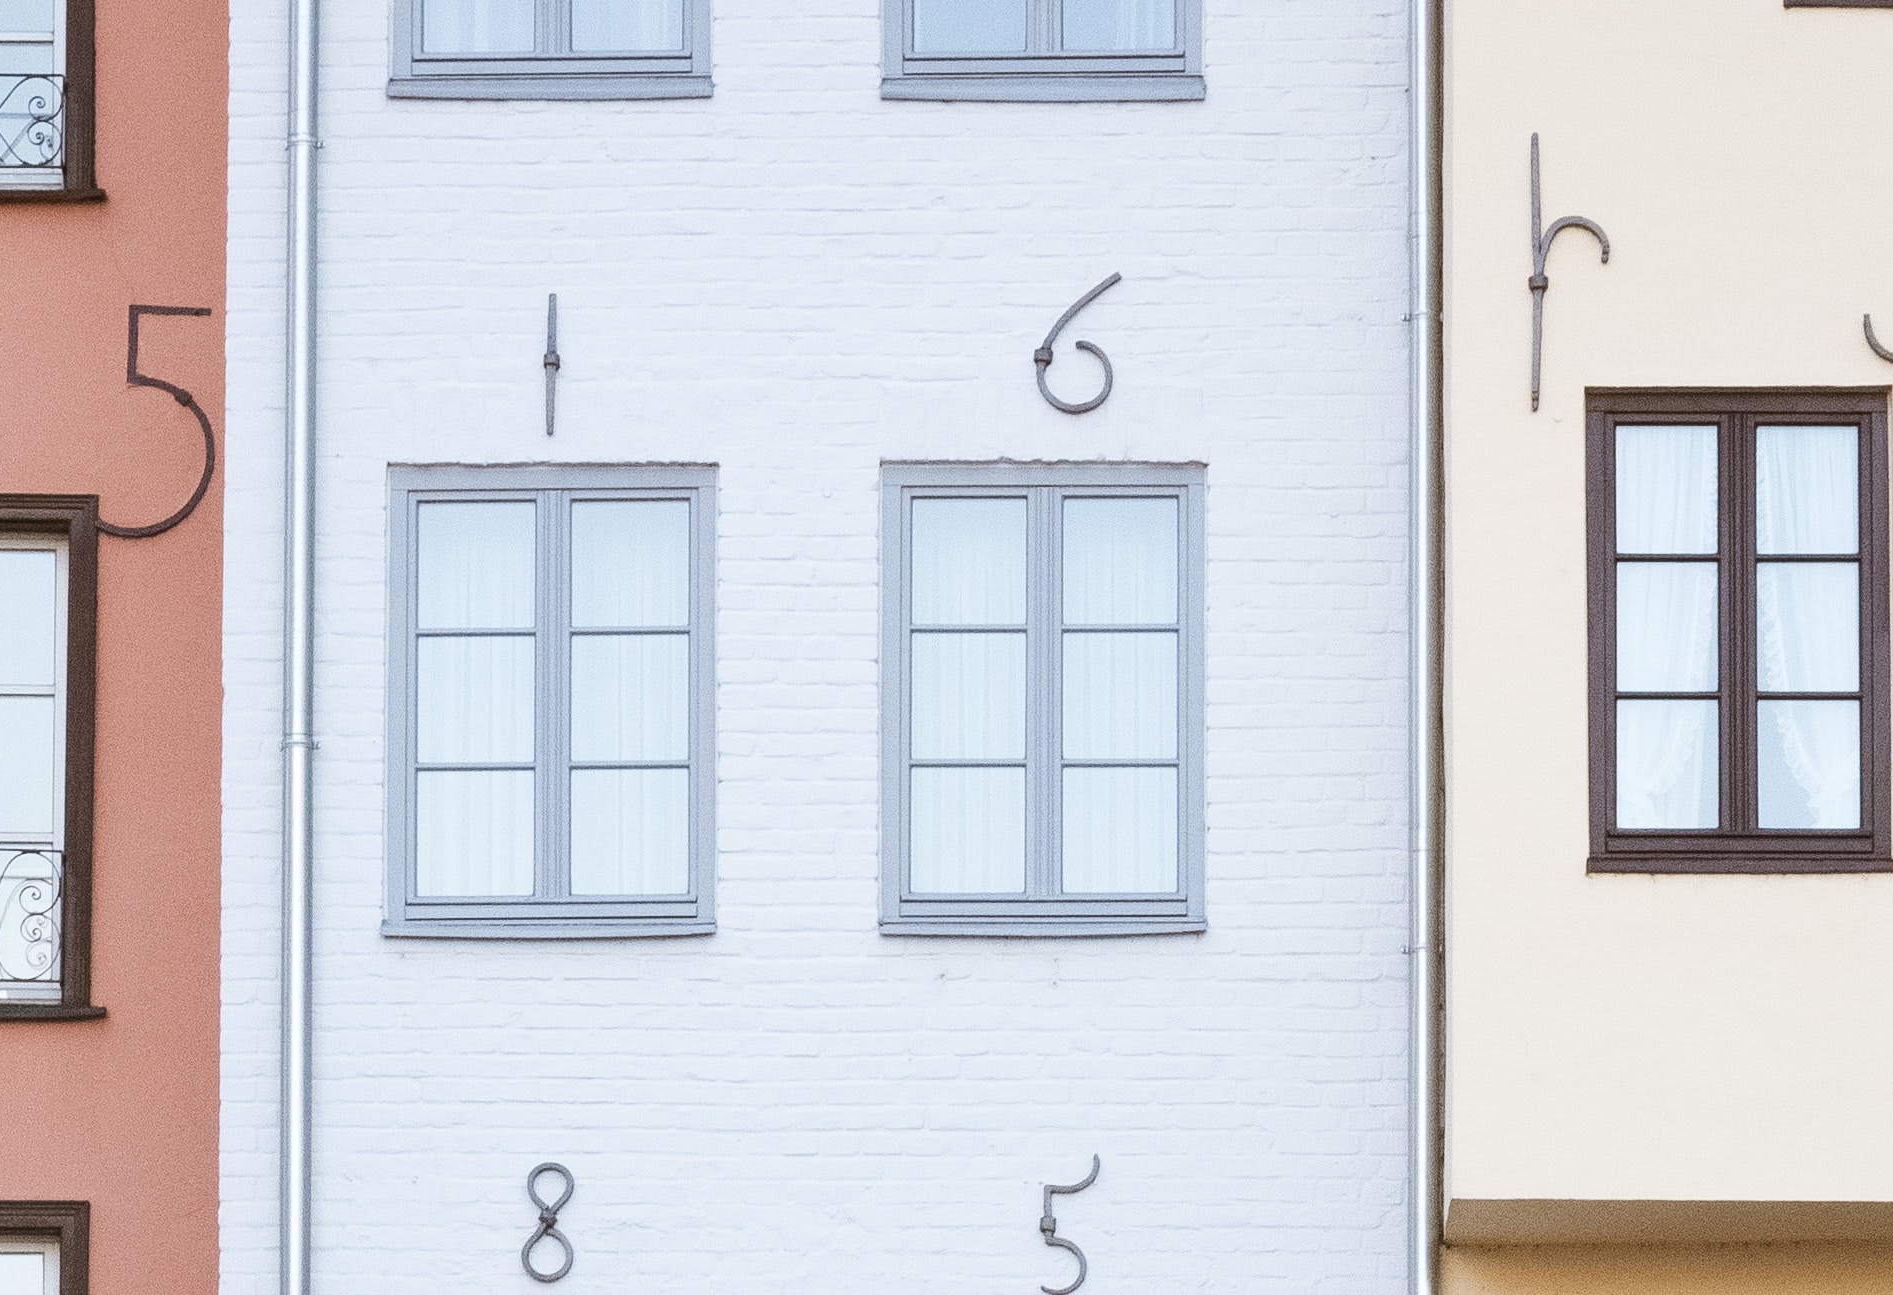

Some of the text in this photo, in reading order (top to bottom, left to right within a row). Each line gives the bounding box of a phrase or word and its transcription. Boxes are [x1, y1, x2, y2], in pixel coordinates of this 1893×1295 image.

[1034, 271, 1123, 415] 6
[97, 304, 216, 538] 5
[521, 1154, 1100, 1295] 8 5
